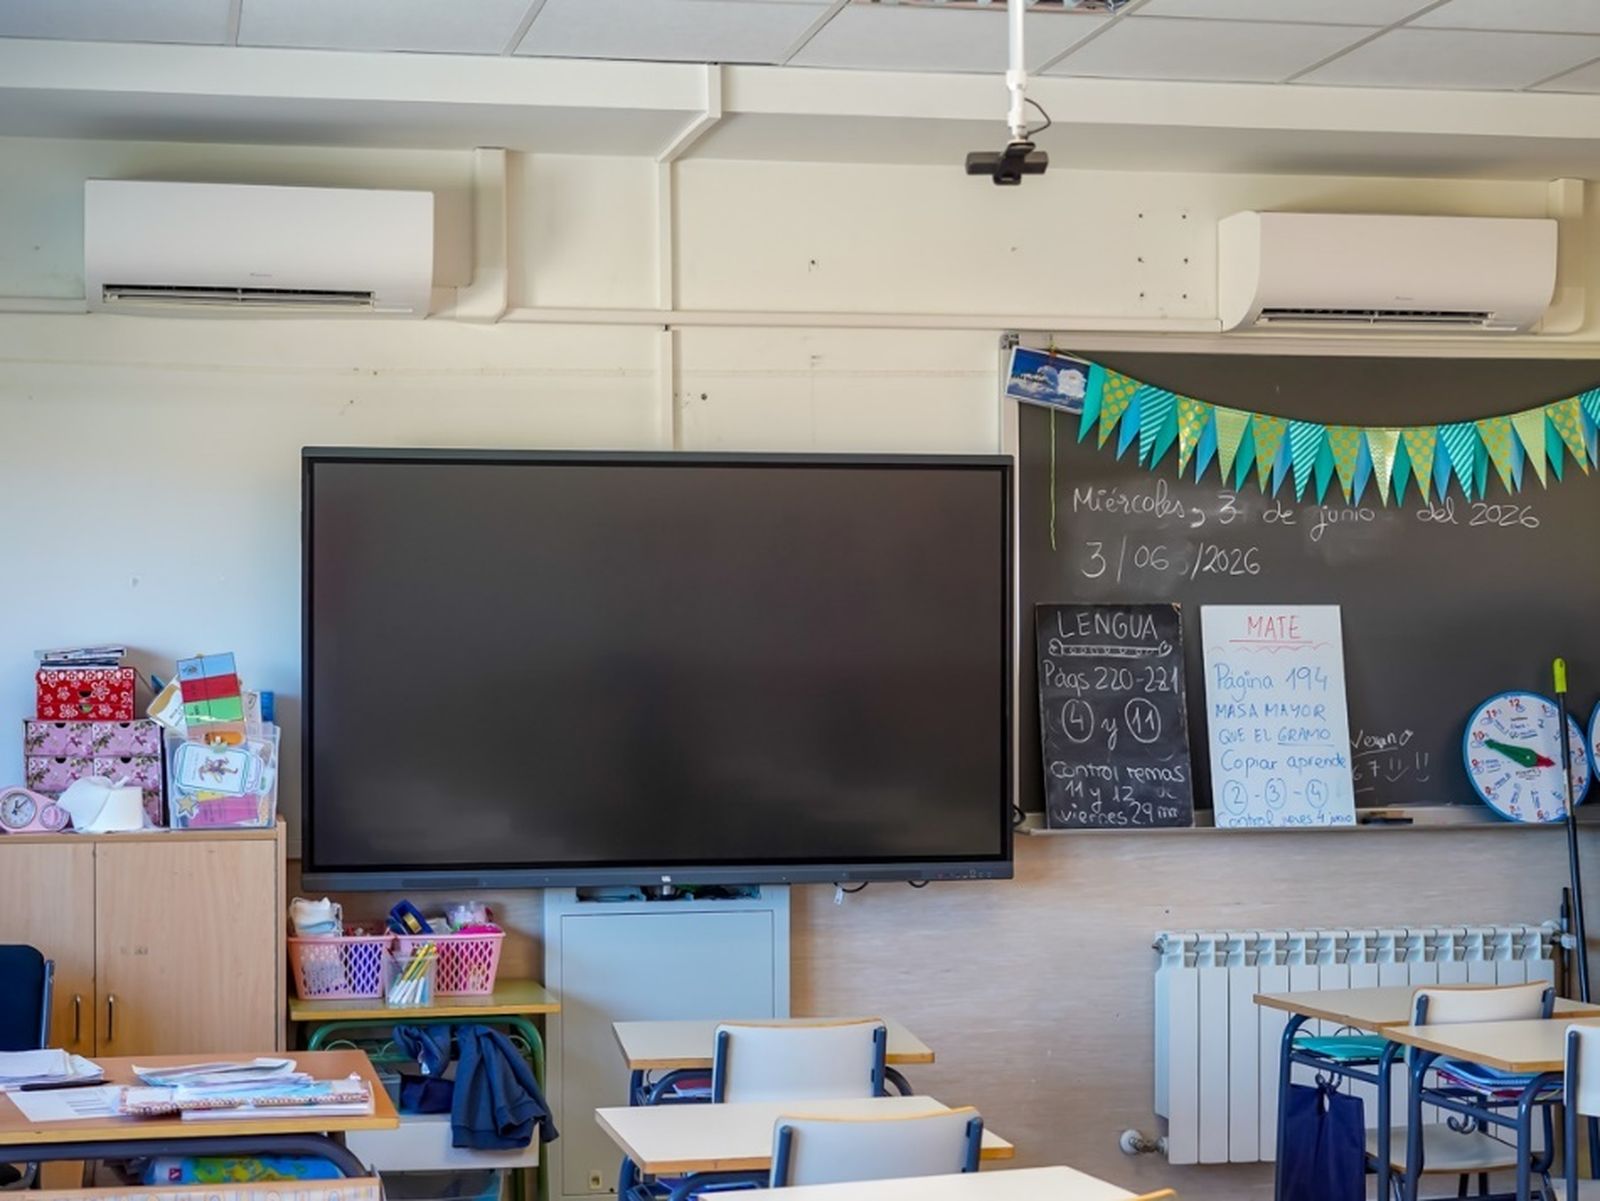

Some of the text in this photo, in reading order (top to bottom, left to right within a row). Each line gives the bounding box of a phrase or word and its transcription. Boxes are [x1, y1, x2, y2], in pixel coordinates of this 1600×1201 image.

[1217, 489, 1239, 524] 3
[1263, 500, 1297, 525] de
[1309, 505, 1375, 542] junio
[1416, 497, 1459, 525] del
[1468, 502, 1540, 528] 2026
[1057, 611, 1158, 640] LENGUA
[1247, 615, 1302, 639] MATE
[1286, 666, 1328, 692] 194
[1215, 703, 1327, 722] MASA MAYOR
[1100, 718, 1118, 751] y
[1131, 706, 1155, 734] 11
[1218, 726, 1333, 746] QUE EL GRAMO
[1220, 749, 1279, 778] Copiar
[1065, 780, 1135, 813] 11 y 12
[1129, 801, 1154, 824] 29
